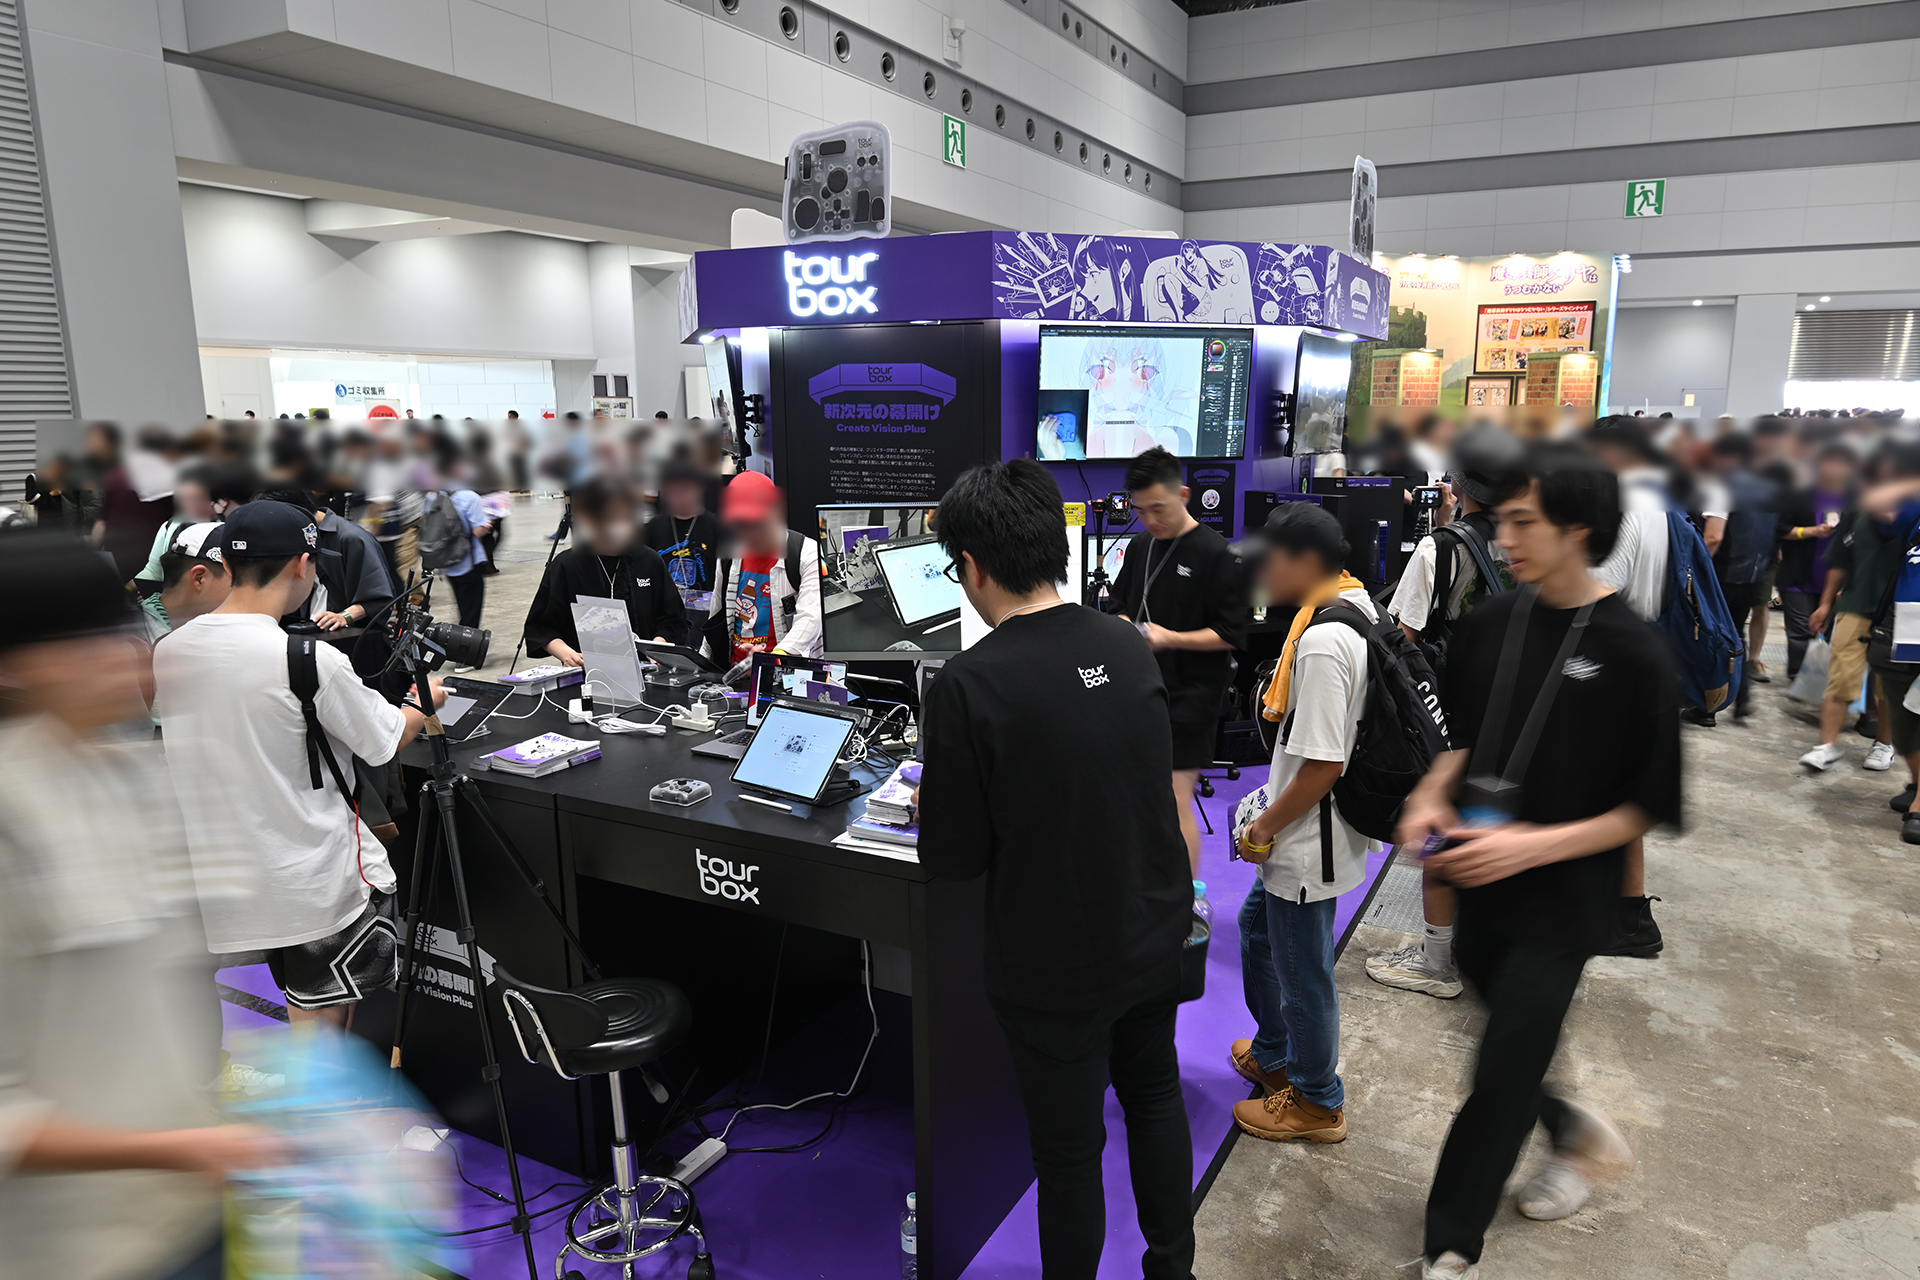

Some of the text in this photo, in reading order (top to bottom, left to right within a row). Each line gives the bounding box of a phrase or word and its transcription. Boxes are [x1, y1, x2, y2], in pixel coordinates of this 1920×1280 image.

[784, 250, 880, 286] tour
[788, 283, 879, 317] box
[867, 365, 893, 375] tour
[869, 373, 893, 383] box
[348, 386, 385, 395] ゴミ収集所
[824, 403, 940, 420] 新次元の幕開け
[836, 424, 927, 434] Create Vision Plus
[1077, 664, 1105, 680] tour
[1083, 674, 1110, 689] box
[695, 848, 760, 884] tour
[700, 874, 761, 906] box
[422, 985, 453, 1003] Vision
[452, 994, 474, 1009] Plus
